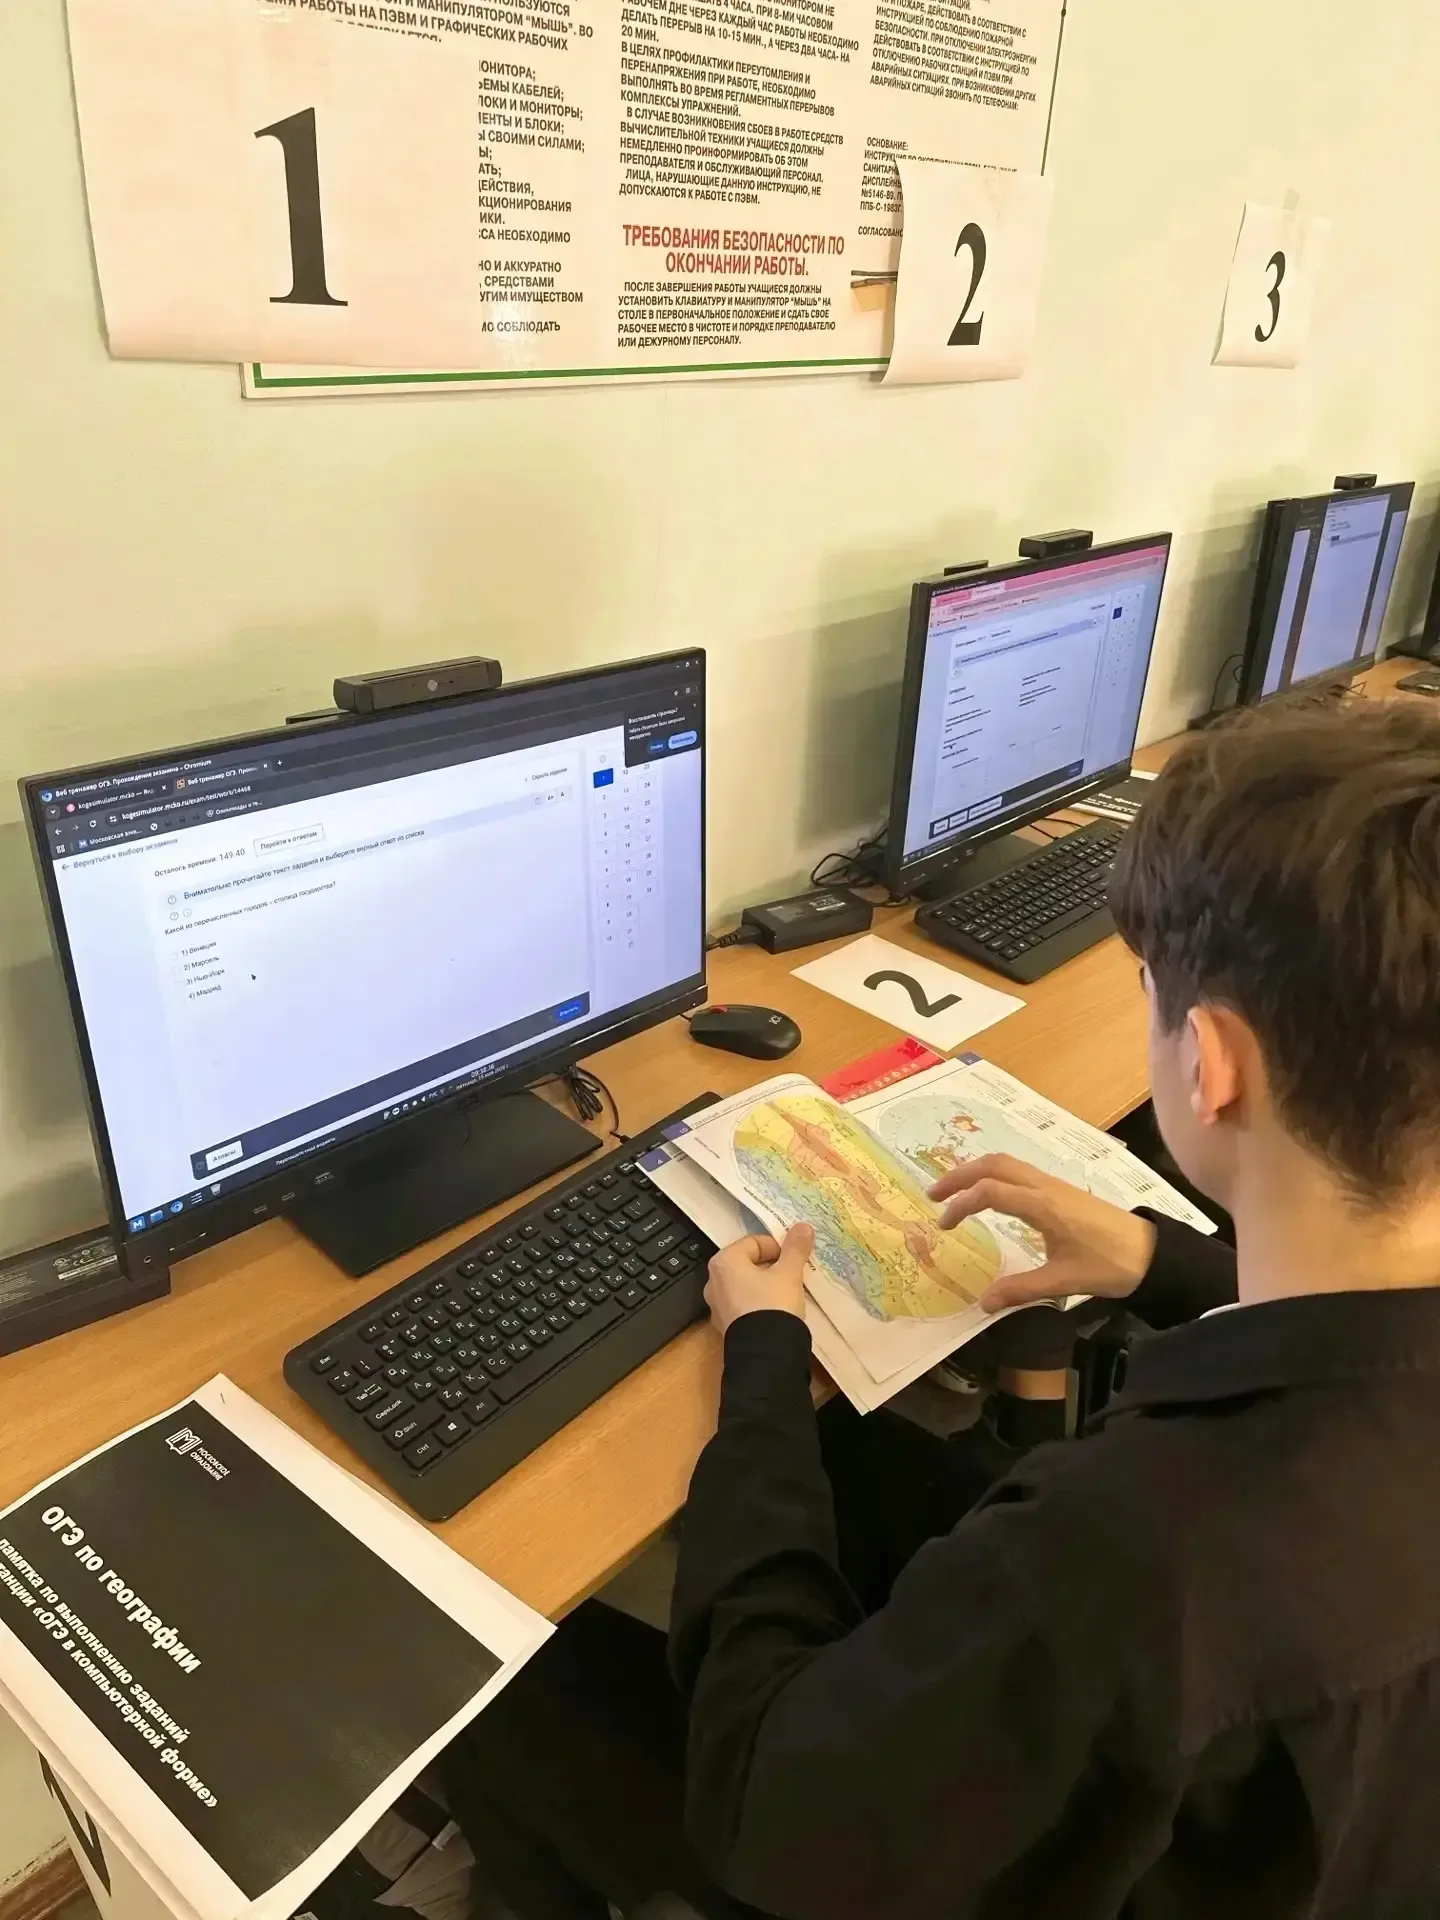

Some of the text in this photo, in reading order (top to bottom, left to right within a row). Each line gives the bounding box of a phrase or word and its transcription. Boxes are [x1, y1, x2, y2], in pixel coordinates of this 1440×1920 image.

[360, 5, 376, 21] НА
[380, 8, 416, 26] ПЭВМ
[420, 13, 428, 28] И
[431, 16, 516, 42] ГРАФИЧЕСКИХ
[518, 31, 568, 50] РАБОЧИХ
[417, 0, 523, 26] МАНИПУЛЯТОРОМ
[579, 25, 593, 37] ВО
[621, 41, 810, 84] В ЦЕЛЯХ ПРОФИЛАКТИКИ ПЕРЕУТОМЛЕНИЯ И
[621, 58, 816, 99] ПЕРЕНАПРЯЖЕНИЯ ПРИ РАБОТЕ, НЕОБХОДИМО
[870, 75, 910, 90] АВАРИЙНЫХ
[912, 82, 944, 97] СИТУАЦИЙ
[945, 88, 973, 102] ЗВОНИТЬ
[973, 94, 981, 104] ПО
[512, 82, 564, 102] КАБЕЛЕЙ;
[621, 74, 834, 116] ВЫПОЛНЯТЬ ВО ВРЕМЯ РЕГЛАМЕНТНЫХ ПЕРЕРЫВОВ
[621, 90, 741, 117] КОМПЛЕКСЫ УПРАЖНЕНИЙ.
[509, 99, 583, 121] И МОНИТОРЫ;
[515, 116, 522, 128] И
[525, 118, 564, 135] БЛОКИ;
[488, 130, 584, 153] СВОИМИ СИЛАМИ;
[254, 106, 349, 307] 1
[498, 229, 570, 244] НЕОБХОДИМО
[623, 224, 845, 255] ТРЕБОВАНИЯ БЕЗОПАСНОСТИ ПО
[494, 260, 561, 272] И АККУРАТНО
[666, 252, 808, 275] ОКОНЧАНИИ РАБОТЫ.
[484, 276, 554, 288] СРЕДСТВАМИ
[625, 282, 822, 295] ПОСЛЕ ЗАВЕРШЕНИЯ РАБОТЫ УЧАЩИЕСЯ ДОЛЖНЫ
[946, 222, 988, 347] 2
[510, 291, 583, 303] ИМУЩЕСТВОМ
[618, 296, 673, 306] УСТАНОВИТЬ
[675, 296, 726, 306] КЛАВИАТУРУ
[728, 297, 732, 306] И
[734, 297, 789, 306] МАНИПУЛЯТОР
[823, 298, 831, 306] НА
[1255, 250, 1286, 342] 3
[618, 309, 829, 320] СТОЛЕ В ПЕРВОНАЧАЛЬНОЕ ПОЛОЖЕНИЕ И СДАТЬ СВОЕ
[497, 321, 560, 333] СОБЛЮДАТЬ
[618, 322, 835, 333] РАБОЧЕЕ МЕСТО В ЧИСТОТЕ И ПОРЯДКЕ ПРЕПОДАВАТЕЛЮ
[618, 336, 741, 348] ИЛИ ДЕЖУРНОМУ ПЕРСОНАЛУ.
[863, 970, 962, 1018] 2
[375, 1399, 402, 1420] CapsLock
[40, 1505, 202, 1674] ОГЭ по географии
[39, 1585, 60, 1605] по
[54, 1601, 134, 1686] выполнению
[129, 1682, 191, 1744] заданий
[32, 1606, 71, 1641] «ОГЭ
[62, 1638, 76, 1651] в
[70, 1645, 168, 1750] компьютерной
[159, 1745, 219, 1809] форме»
